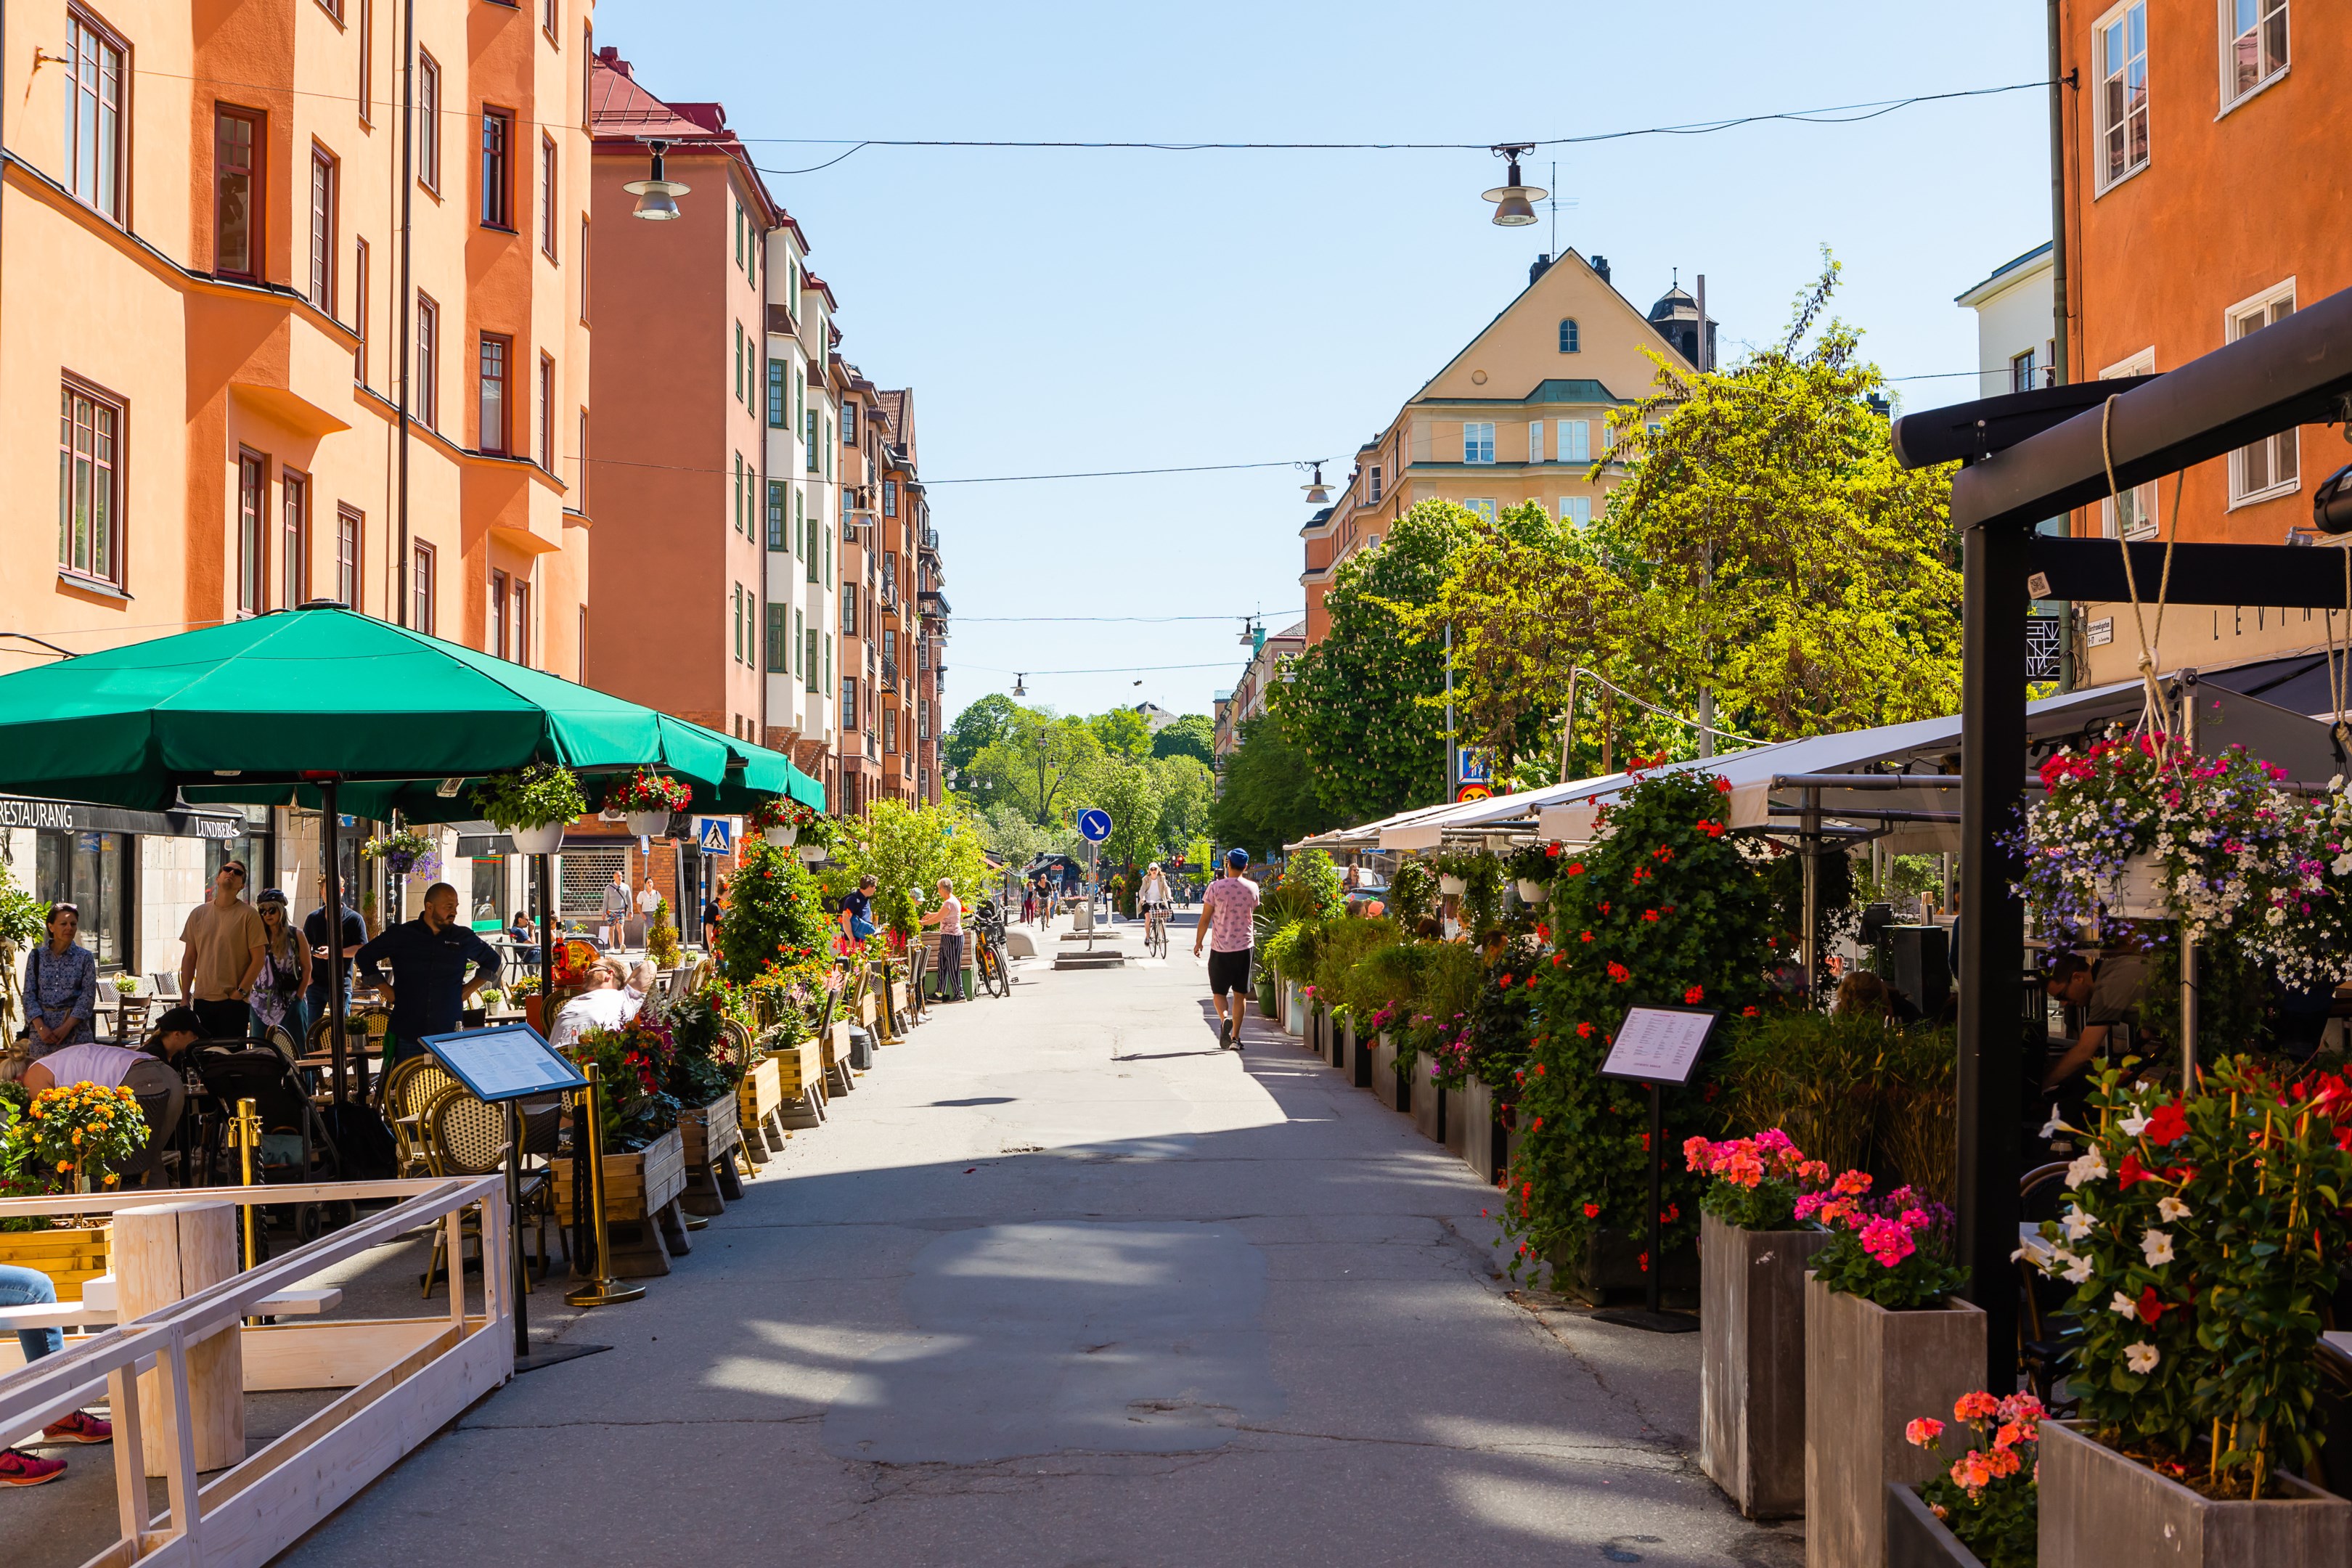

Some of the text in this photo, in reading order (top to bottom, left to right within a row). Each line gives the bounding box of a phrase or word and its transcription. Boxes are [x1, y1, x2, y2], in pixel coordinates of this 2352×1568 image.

[2214, 605, 2338, 640] LEVI
[0, 801, 73, 828] RESTAURANG
[195, 817, 241, 838] LUNDBERG
